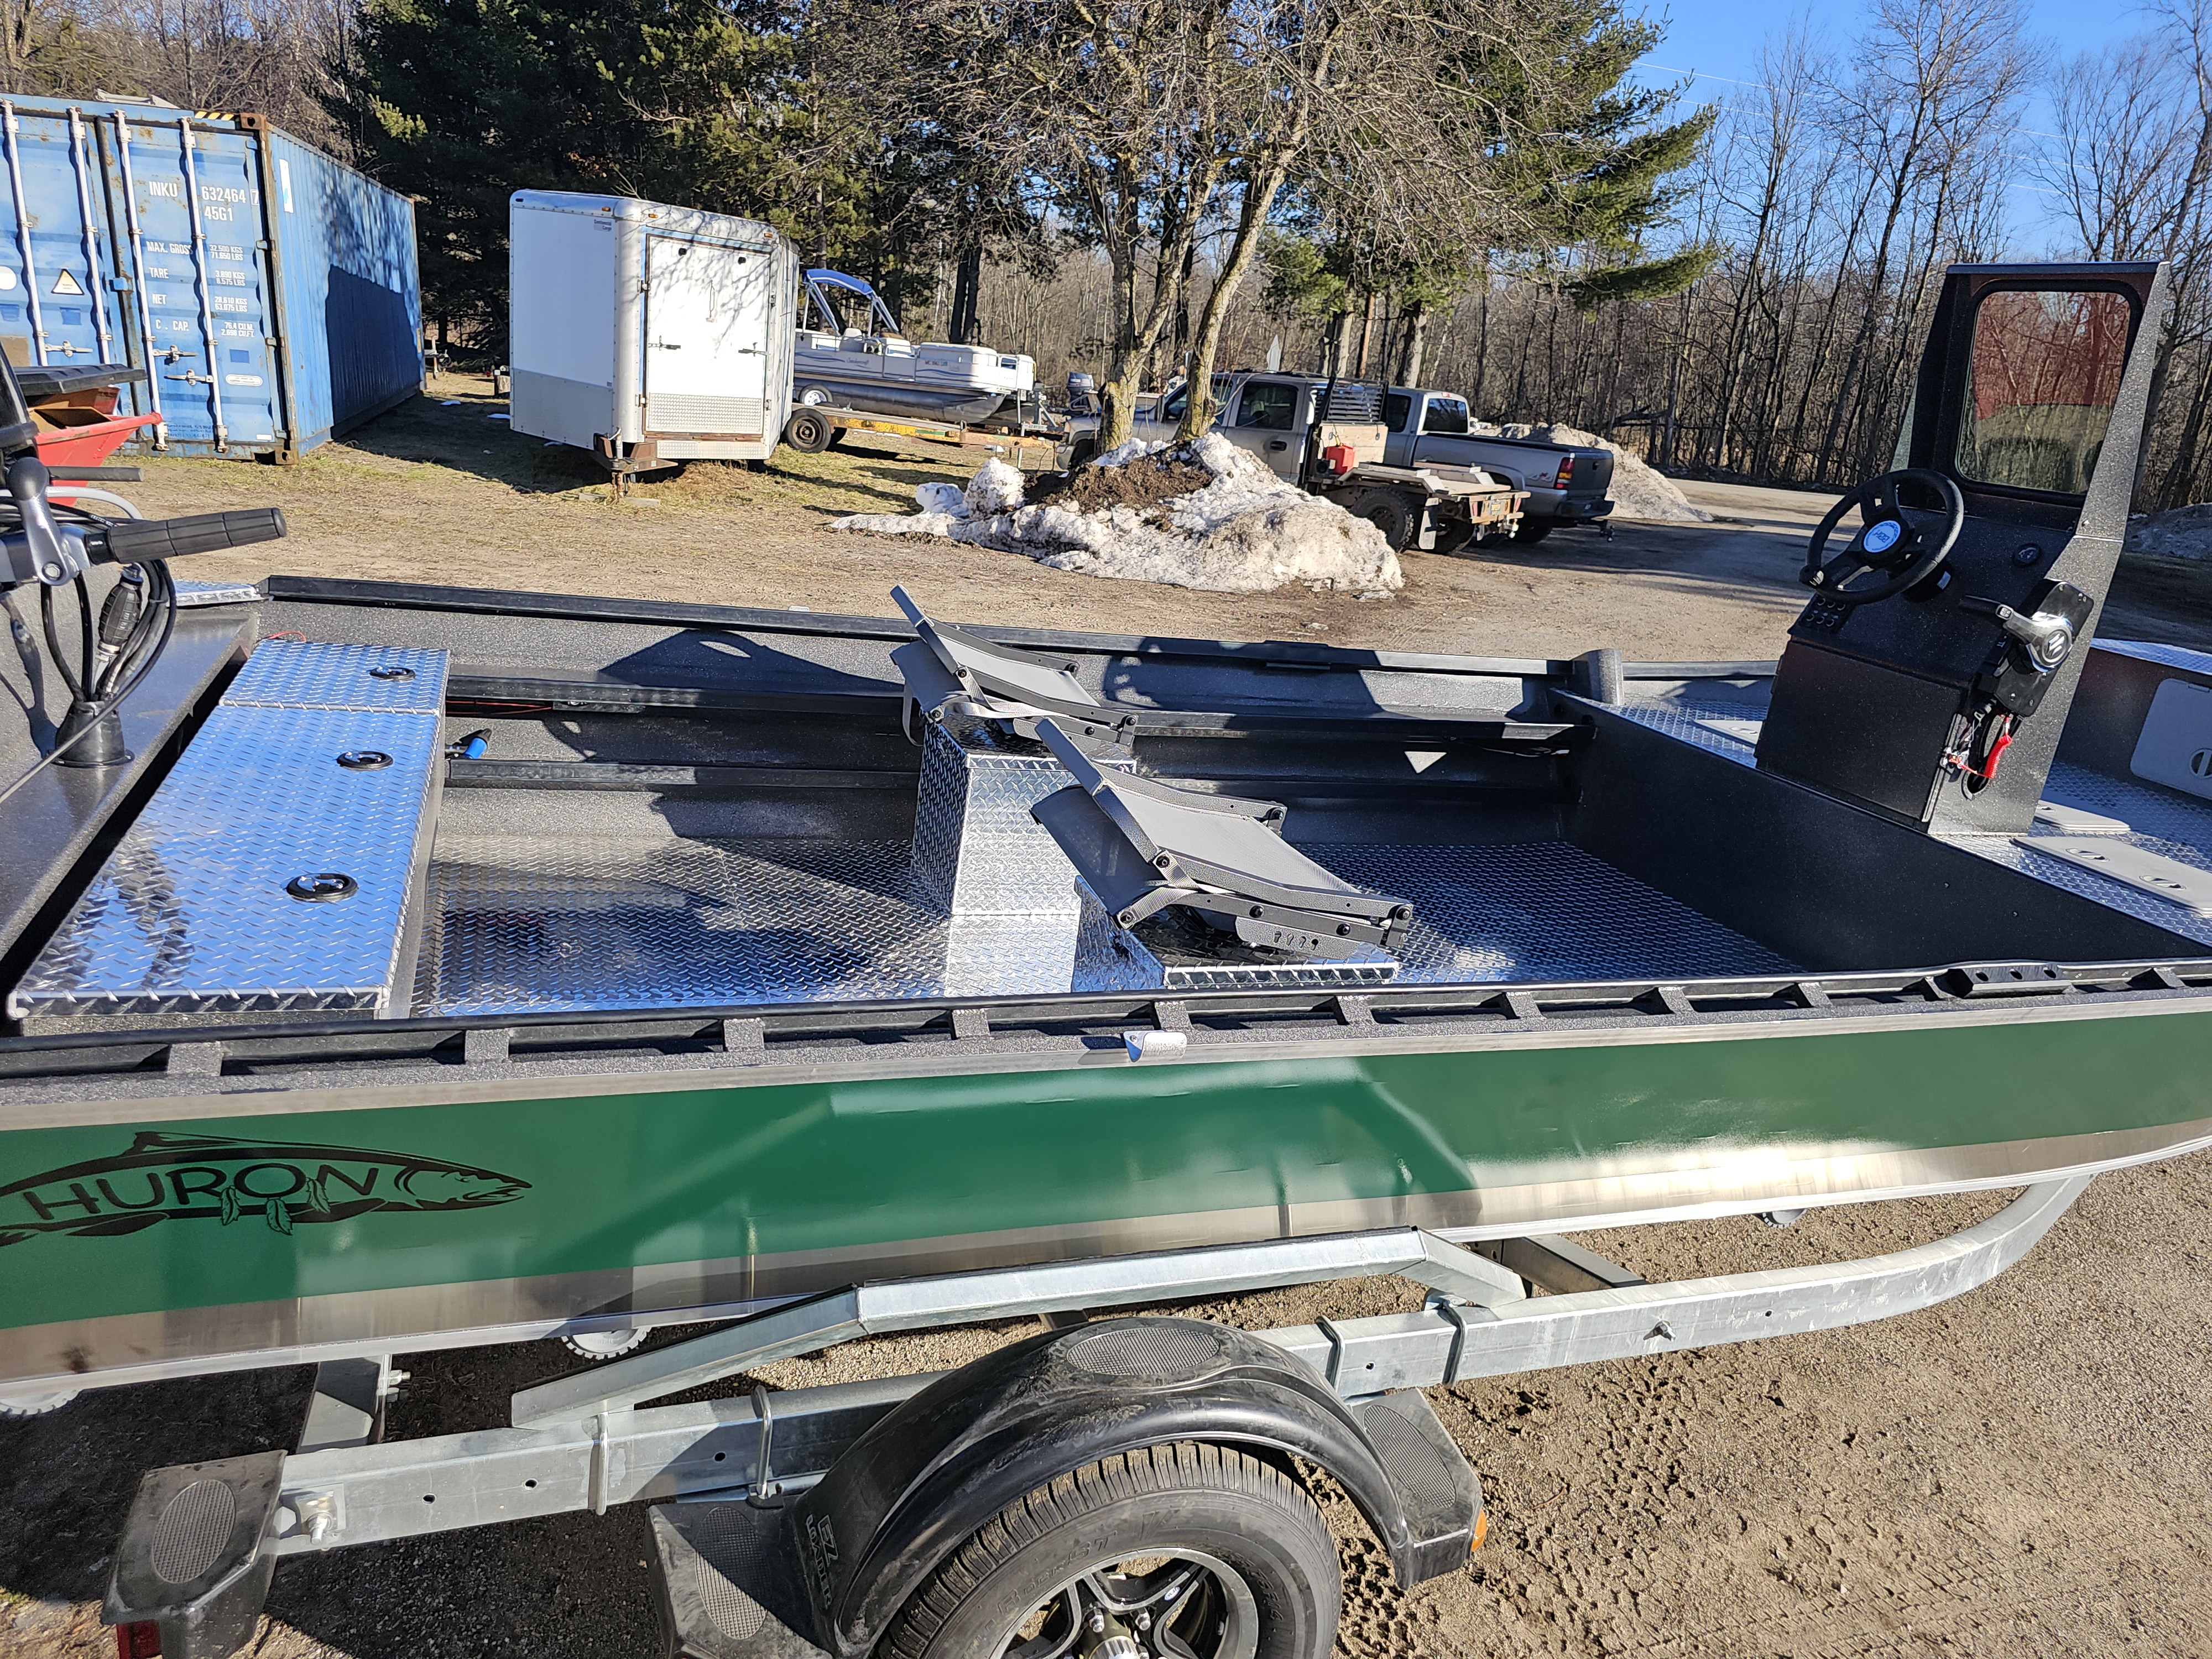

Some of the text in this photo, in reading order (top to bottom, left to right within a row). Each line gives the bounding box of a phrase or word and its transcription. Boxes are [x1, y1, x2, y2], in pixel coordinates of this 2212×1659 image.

[149, 181, 259, 205] INKU 632464 7
[205, 205, 233, 222] 45G1
[145, 241, 194, 255] MAX. GROSS
[232, 253, 243, 261] LBS
[148, 267, 169, 279] TARE
[233, 272, 245, 280] KGS
[152, 293, 167, 305] NET
[235, 297, 248, 305] KGS
[236, 304, 248, 312] LBS
[173, 320, 190, 332] CAP.
[23, 1162, 379, 1220] HURON
[817, 1514, 839, 1567] EZ
[806, 1514, 832, 1610] LOADER
